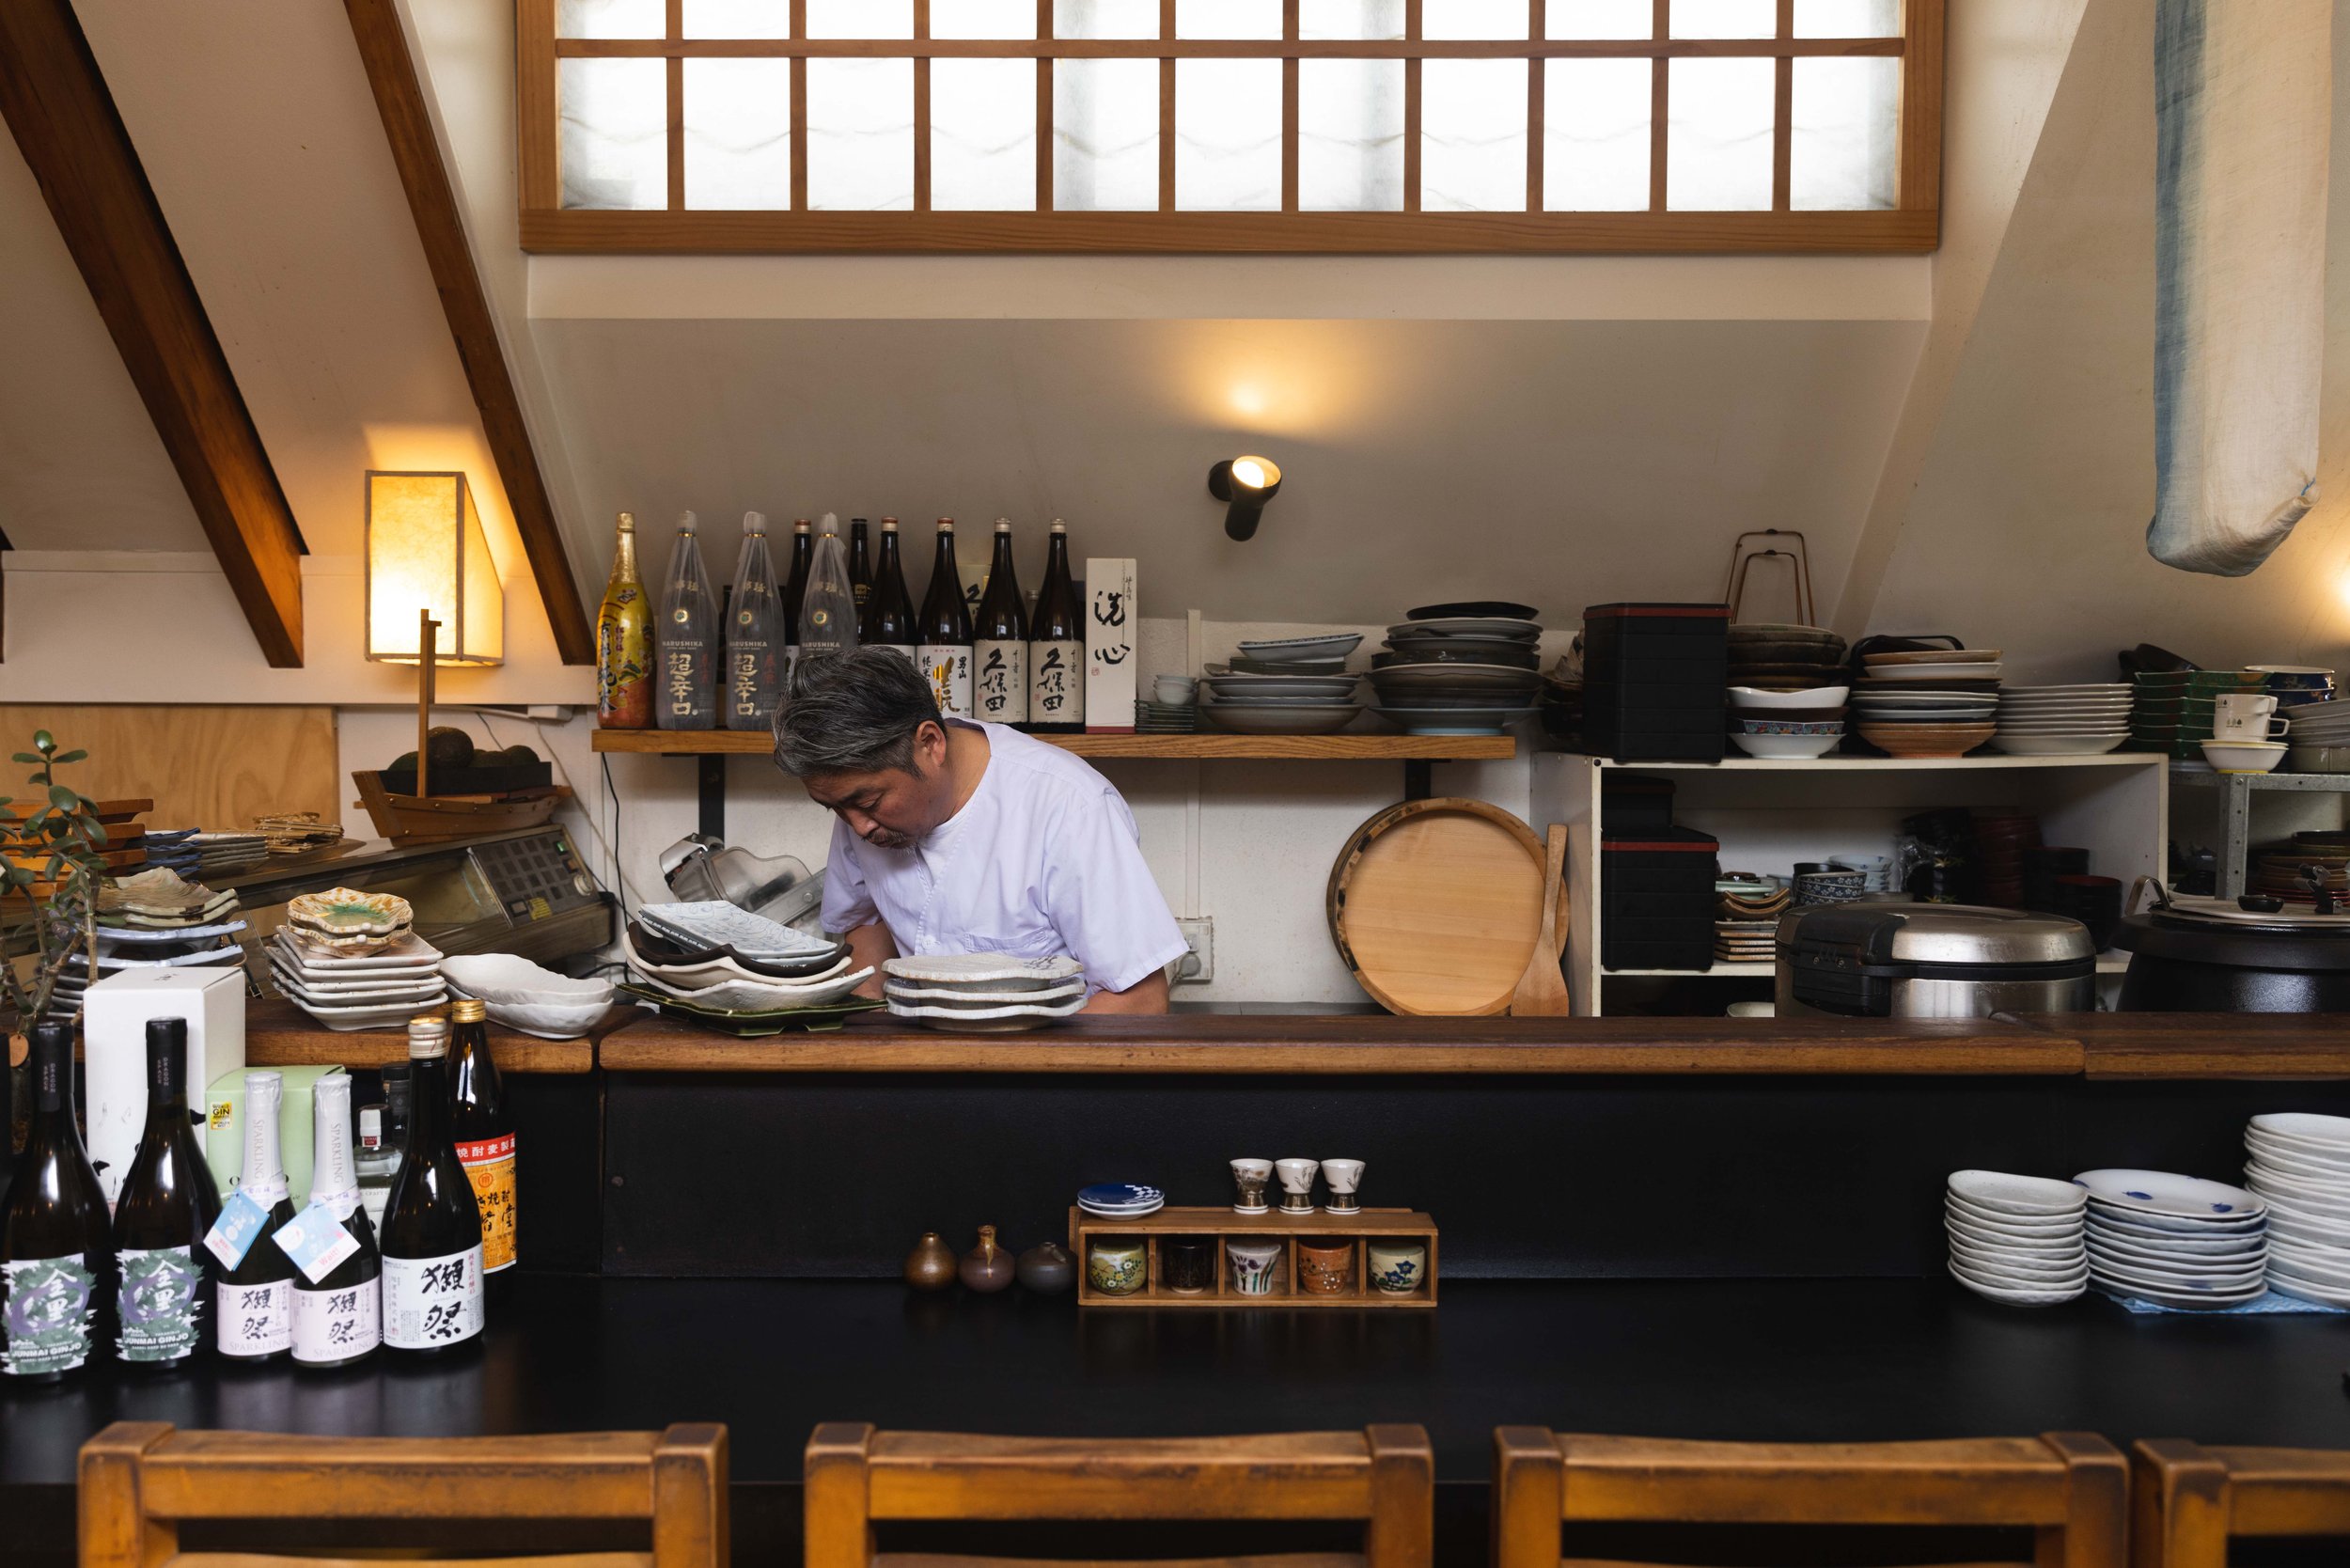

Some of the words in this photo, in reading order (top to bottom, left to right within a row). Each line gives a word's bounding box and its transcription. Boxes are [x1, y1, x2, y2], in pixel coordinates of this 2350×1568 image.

[667, 652, 694, 715] 超辛口
[734, 653, 758, 716] 超辛口
[958, 656, 967, 679] 男山
[979, 647, 1007, 712] 久保田
[1037, 647, 1065, 711] 久保田
[254, 1120, 264, 1180] SPARKLING
[331, 1123, 344, 1184] SPARKLING
[50, 1341, 82, 1355] GINJO
[158, 1333, 189, 1343] GINJO
[229, 1337, 290, 1351] SPARKLING
[314, 1341, 373, 1357] SPARKLING
